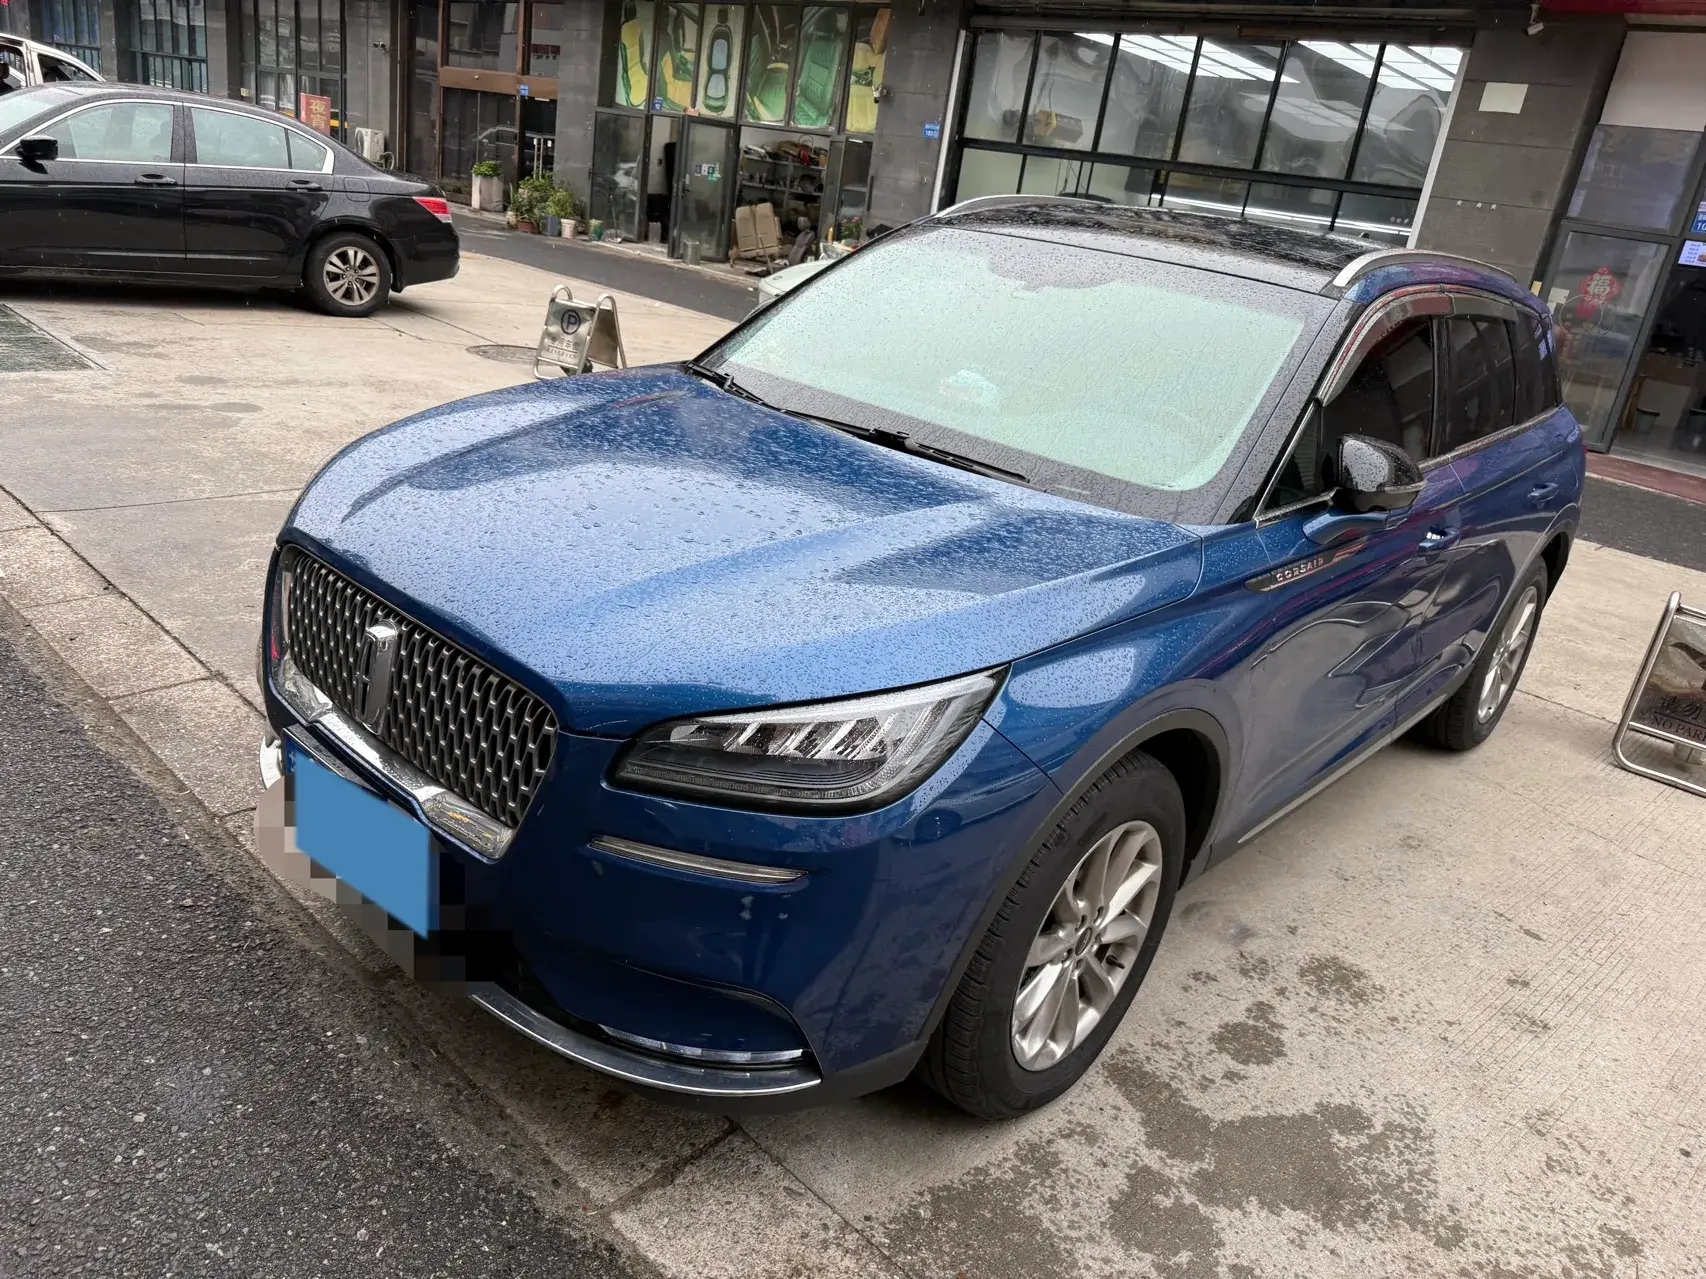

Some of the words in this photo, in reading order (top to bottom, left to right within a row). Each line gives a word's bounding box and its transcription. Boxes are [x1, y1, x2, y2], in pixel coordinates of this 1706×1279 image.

[1587, 273, 1611, 295] 福
[1276, 557, 1324, 582] CORSAIR
[1659, 694, 1706, 723] 请勿
[1651, 714, 1673, 730] NO
